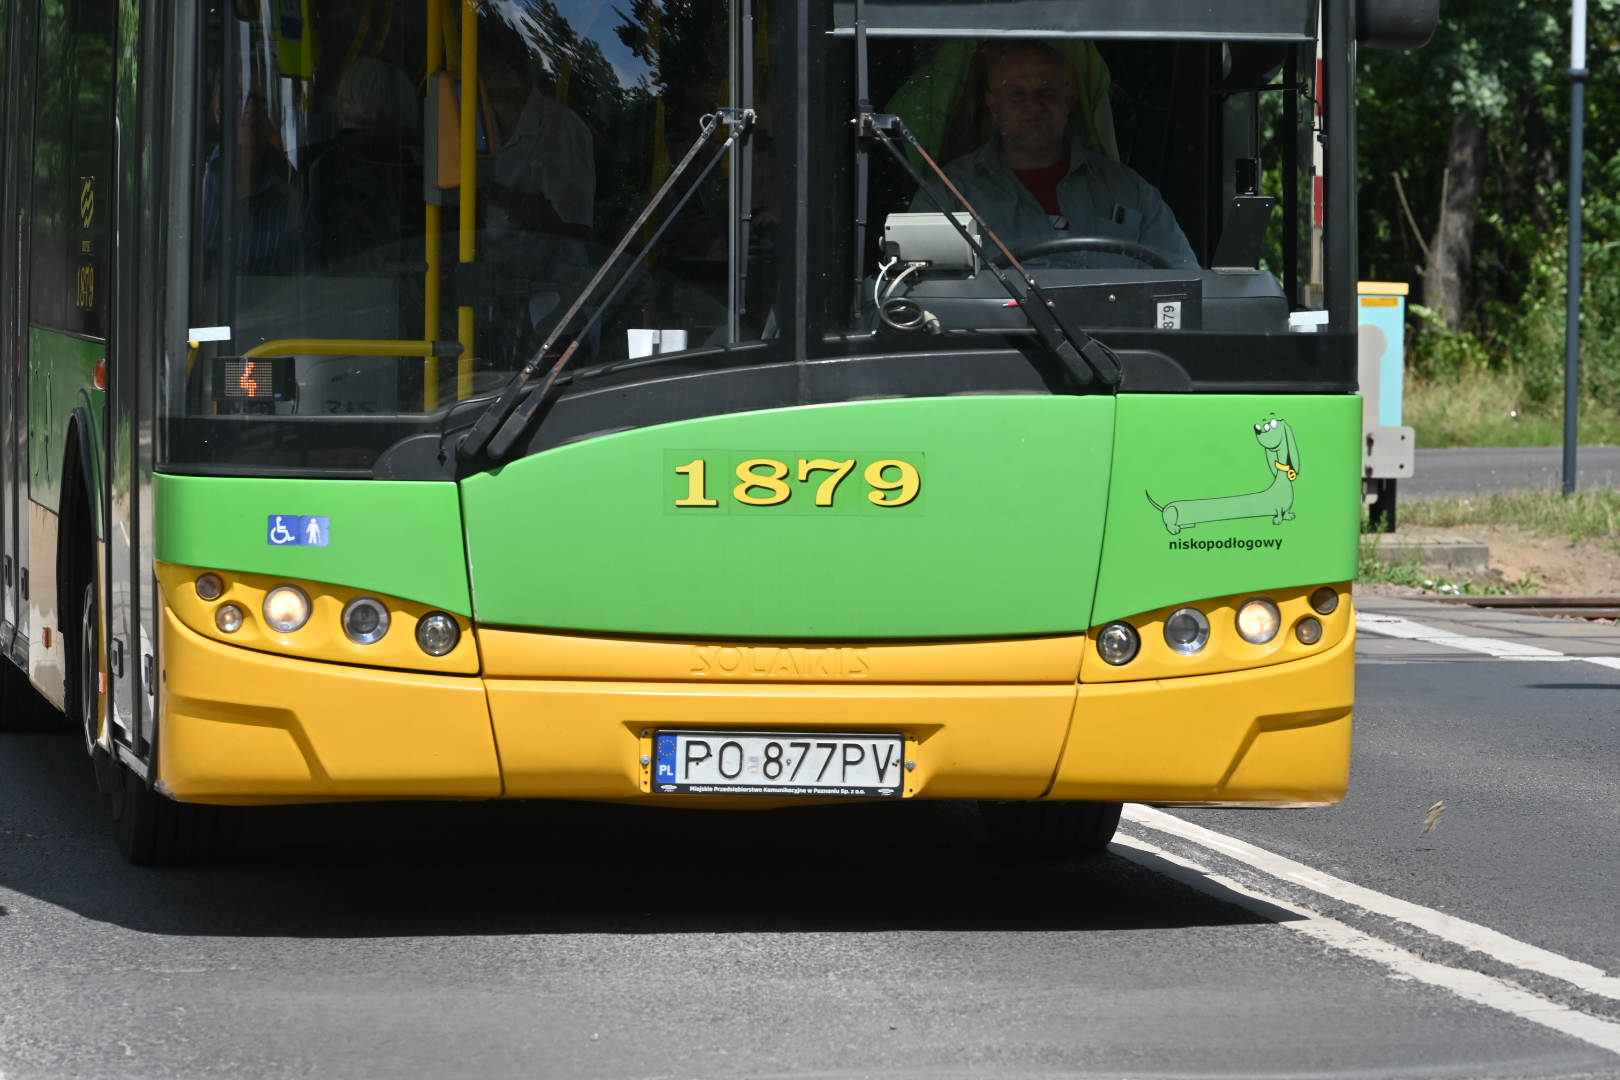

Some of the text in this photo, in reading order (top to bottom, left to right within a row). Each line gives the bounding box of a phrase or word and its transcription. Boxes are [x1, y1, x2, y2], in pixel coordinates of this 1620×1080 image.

[76, 266, 94, 307] 1879
[240, 361, 258, 397] 4
[675, 458, 921, 508] 1879
[1169, 537, 1283, 551] niskopodłogowy
[690, 645, 869, 677] SOLARIS
[659, 765, 674, 776] PL
[684, 740, 895, 783] PO 877PV
[689, 785, 713, 793] Miejskie
[763, 787, 806, 795] Komunikacyjne
